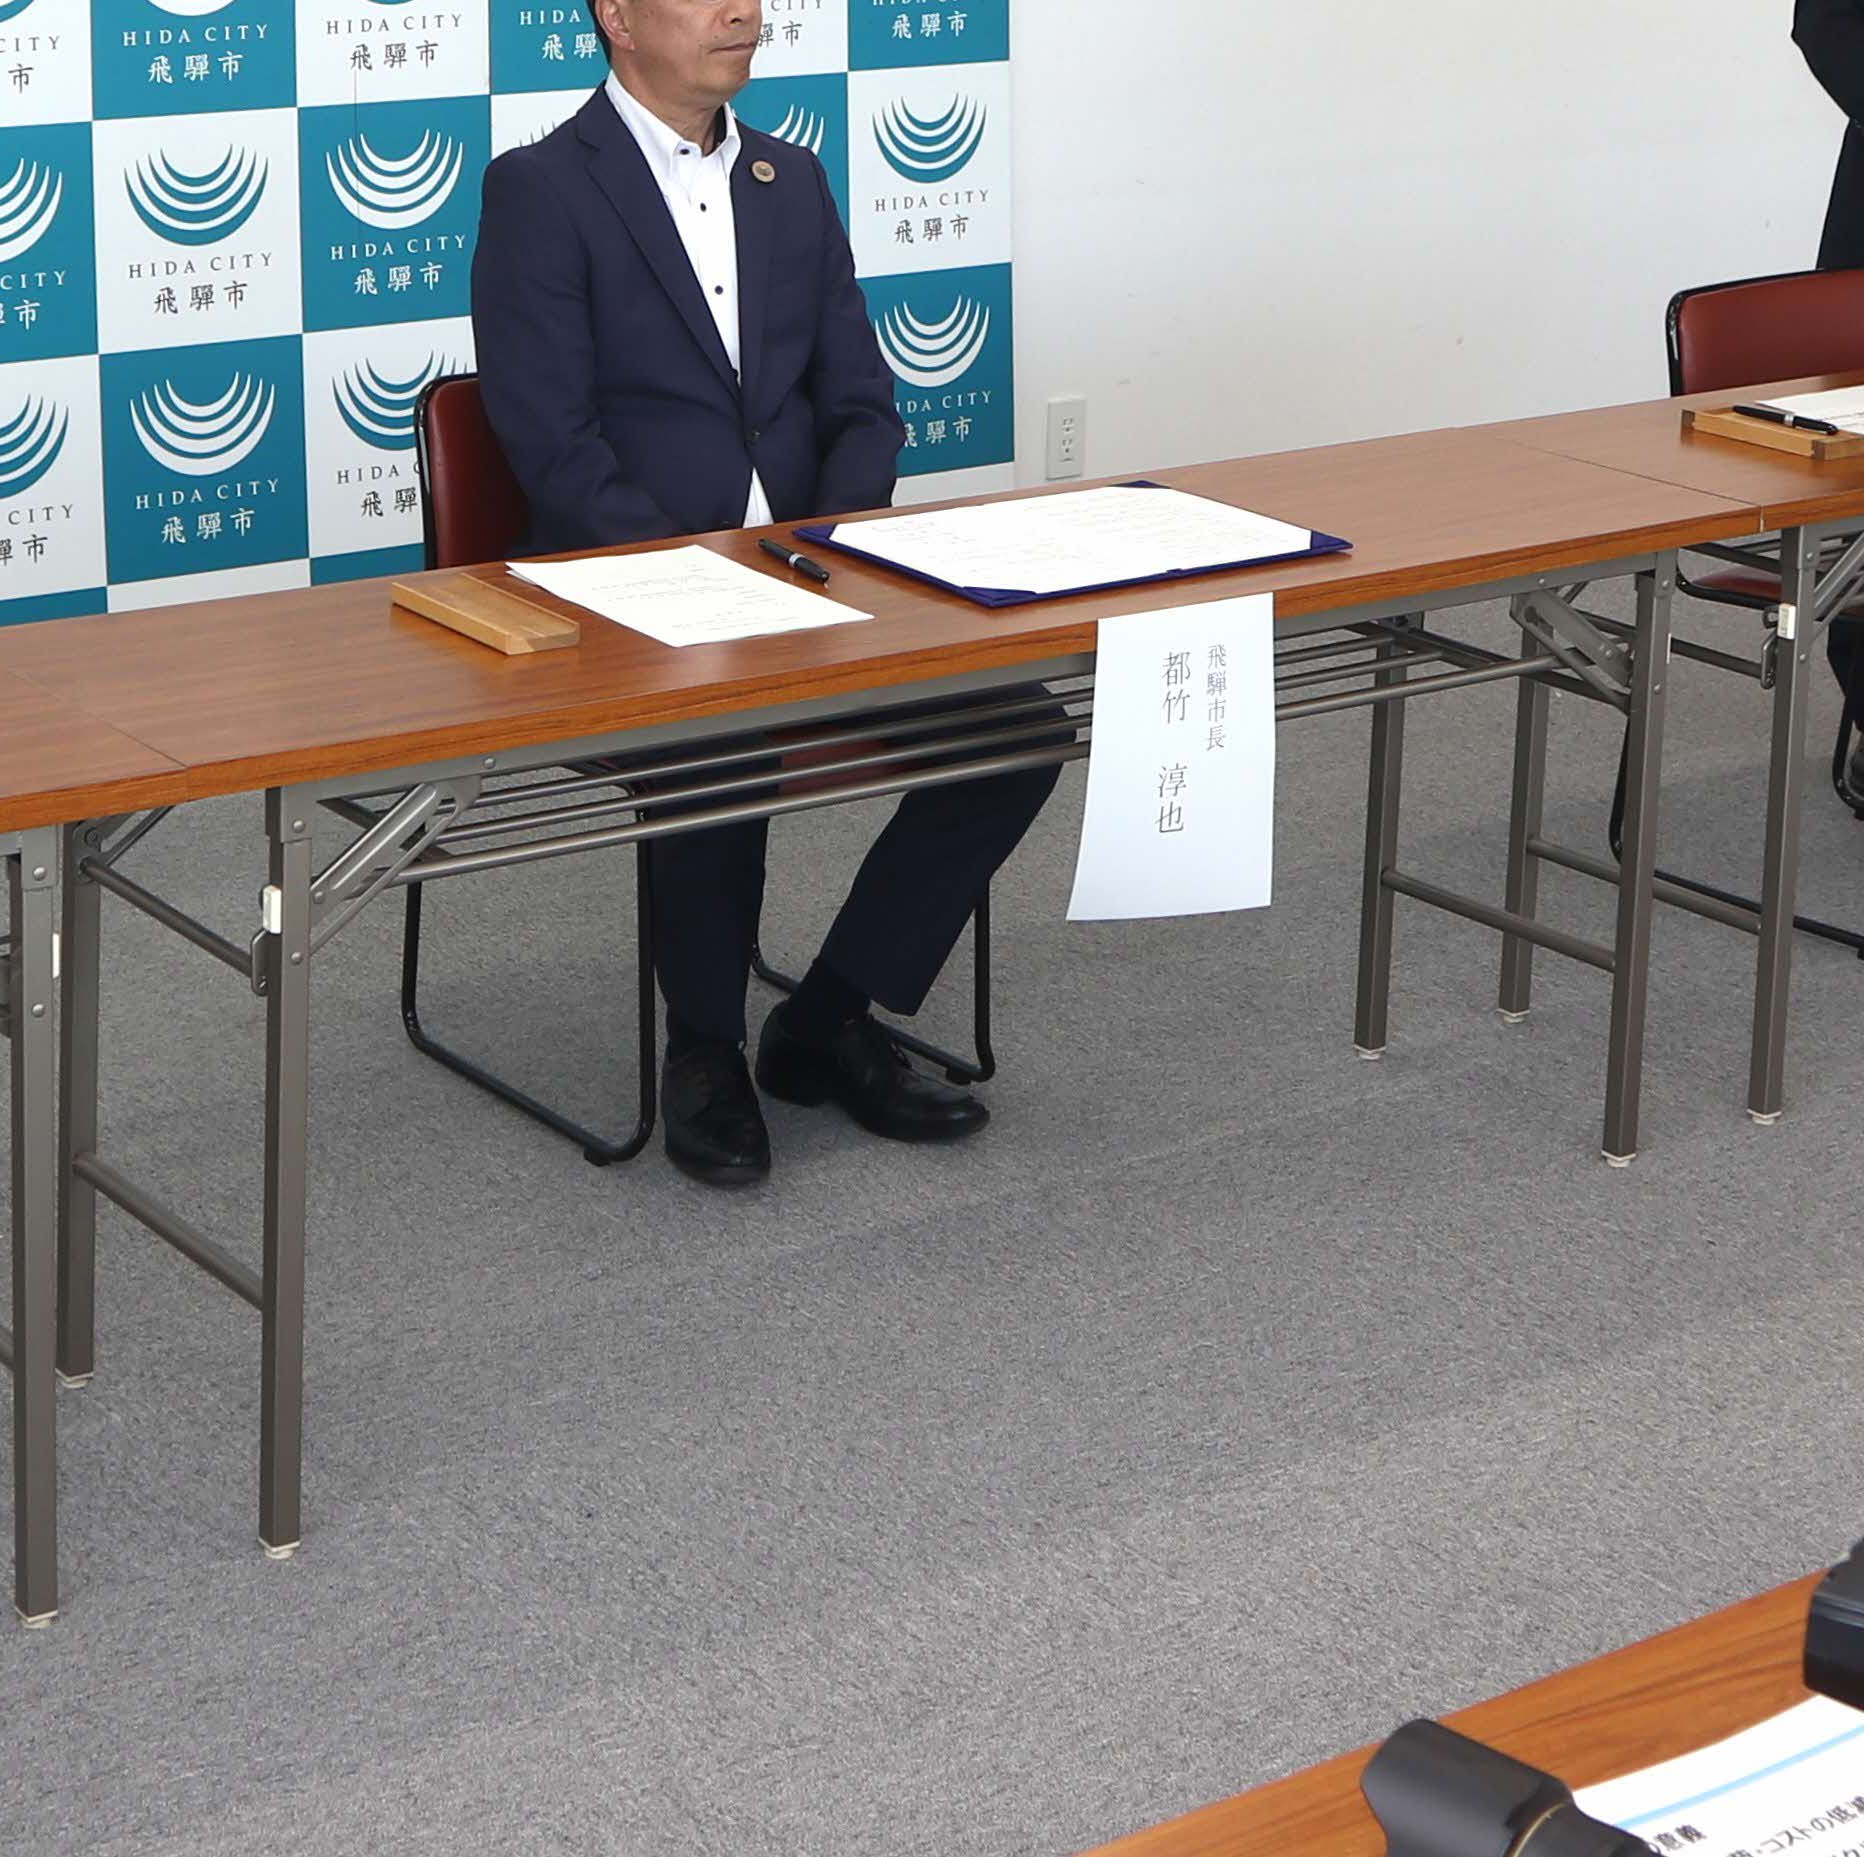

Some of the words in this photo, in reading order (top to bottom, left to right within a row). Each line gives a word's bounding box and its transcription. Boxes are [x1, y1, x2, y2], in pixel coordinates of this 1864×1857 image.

[519, 9, 581, 25] HIDA
[122, 28, 192, 47] HIDA
[203, 23, 268, 42] CITY
[874, 195, 929, 213] HIDA
[938, 189, 989, 207] CITY
[330, 241, 395, 261] HIDA
[406, 234, 466, 254] CITY
[0, 270, 66, 291] CITY
[896, 399, 932, 413] IDA
[942, 390, 992, 409] CITY
[337, 464, 400, 484] HIDA
[135, 488, 203, 510] HIDA
[216, 478, 279, 500] CITY
[7, 503, 73, 526] CITY
[1161, 651, 1192, 724] 都竹
[1205, 643, 1228, 752] 飛騨市長
[1154, 761, 1189, 834] 淳也
